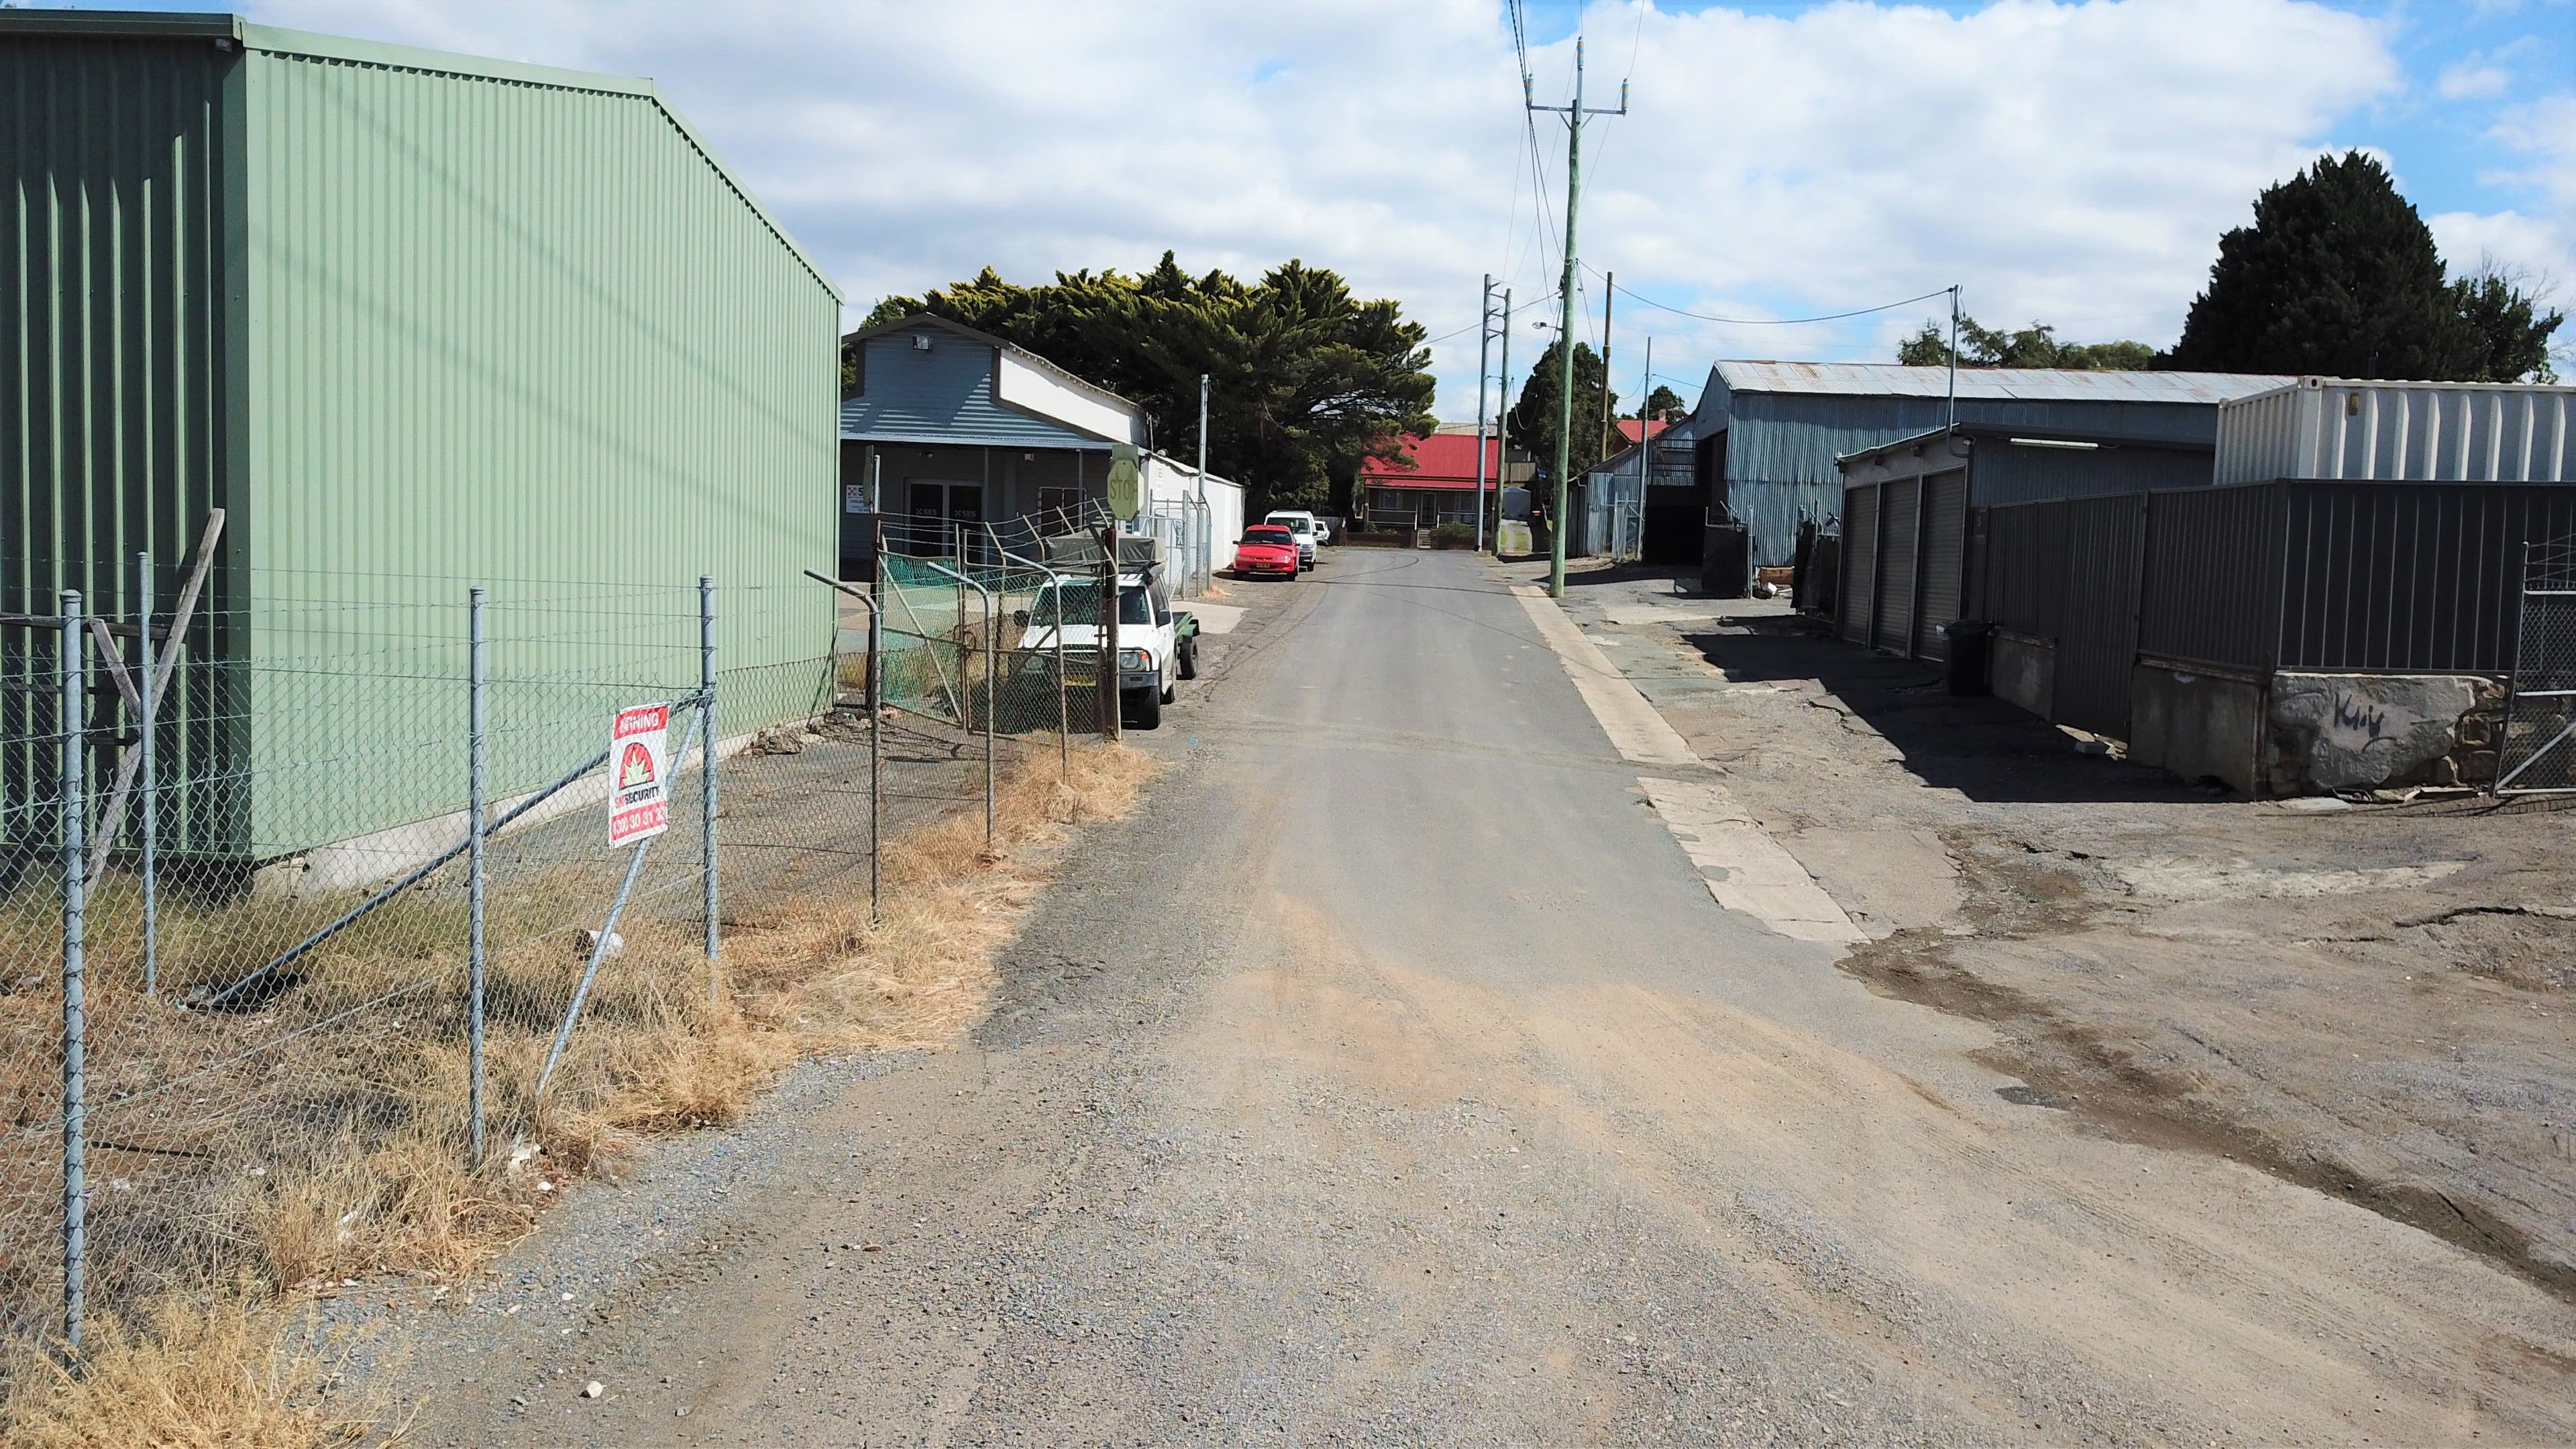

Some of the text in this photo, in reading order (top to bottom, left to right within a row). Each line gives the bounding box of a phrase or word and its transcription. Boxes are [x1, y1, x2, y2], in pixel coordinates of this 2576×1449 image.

[1110, 478, 1138, 500] STOP
[630, 812, 641, 829] 30
[642, 809, 653, 826] 31
